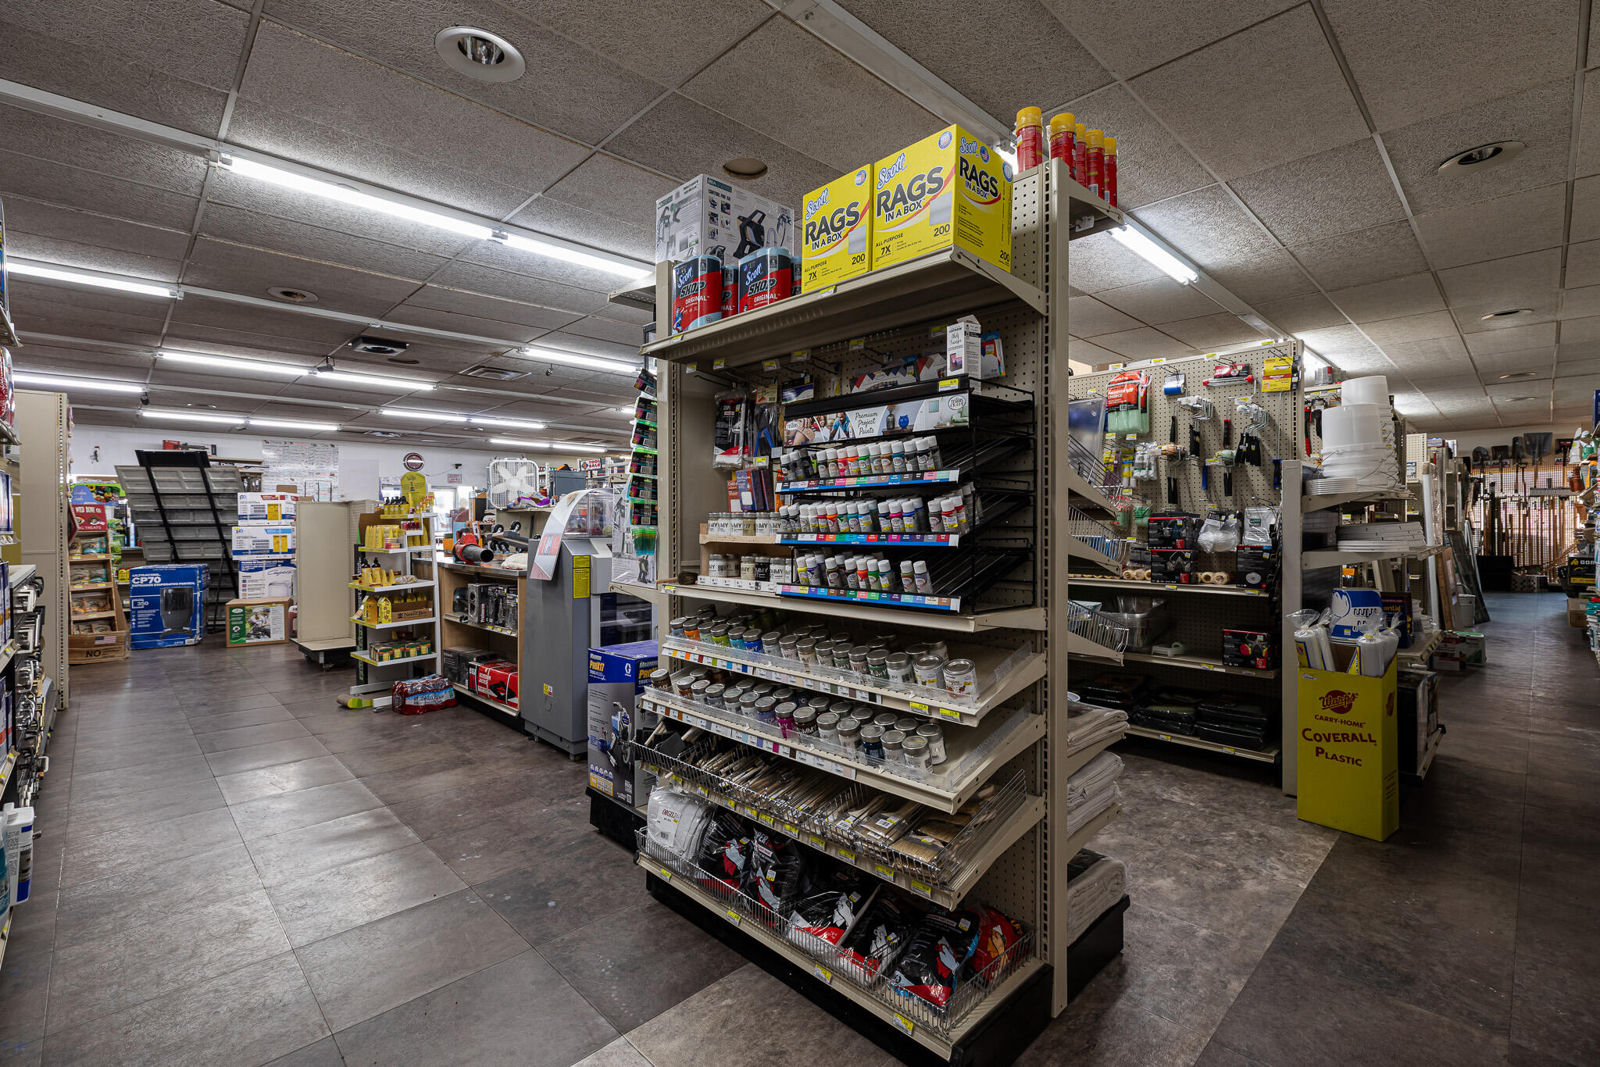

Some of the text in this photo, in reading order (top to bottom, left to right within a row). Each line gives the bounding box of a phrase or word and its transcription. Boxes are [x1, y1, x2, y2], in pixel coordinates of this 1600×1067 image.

[959, 136, 979, 155] Scott
[877, 152, 909, 190] Scott
[959, 156, 999, 198] RAGS
[876, 166, 944, 218] RAGS
[805, 187, 831, 221] Scott
[885, 200, 923, 223] IN A BOX
[805, 201, 860, 245] RAGS
[933, 223, 951, 238] 200
[812, 231, 843, 251] IN A BOX
[880, 245, 891, 255] 7X
[851, 253, 866, 266] 200
[677, 266, 693, 288] Scott
[745, 262, 763, 286] Scott
[808, 271, 817, 280] 7X
[680, 280, 707, 299] SHOP
[747, 278, 777, 297] SHOP
[685, 295, 708, 305] ORIGINAL
[753, 293, 779, 303] ORIGINAL
[132, 576, 162, 585] CP70
[86, 650, 101, 658] NO
[1314, 714, 1364, 729] CARRY-HOME
[1301, 728, 1377, 744] COVERALL
[1315, 746, 1363, 767] PLASTIC
